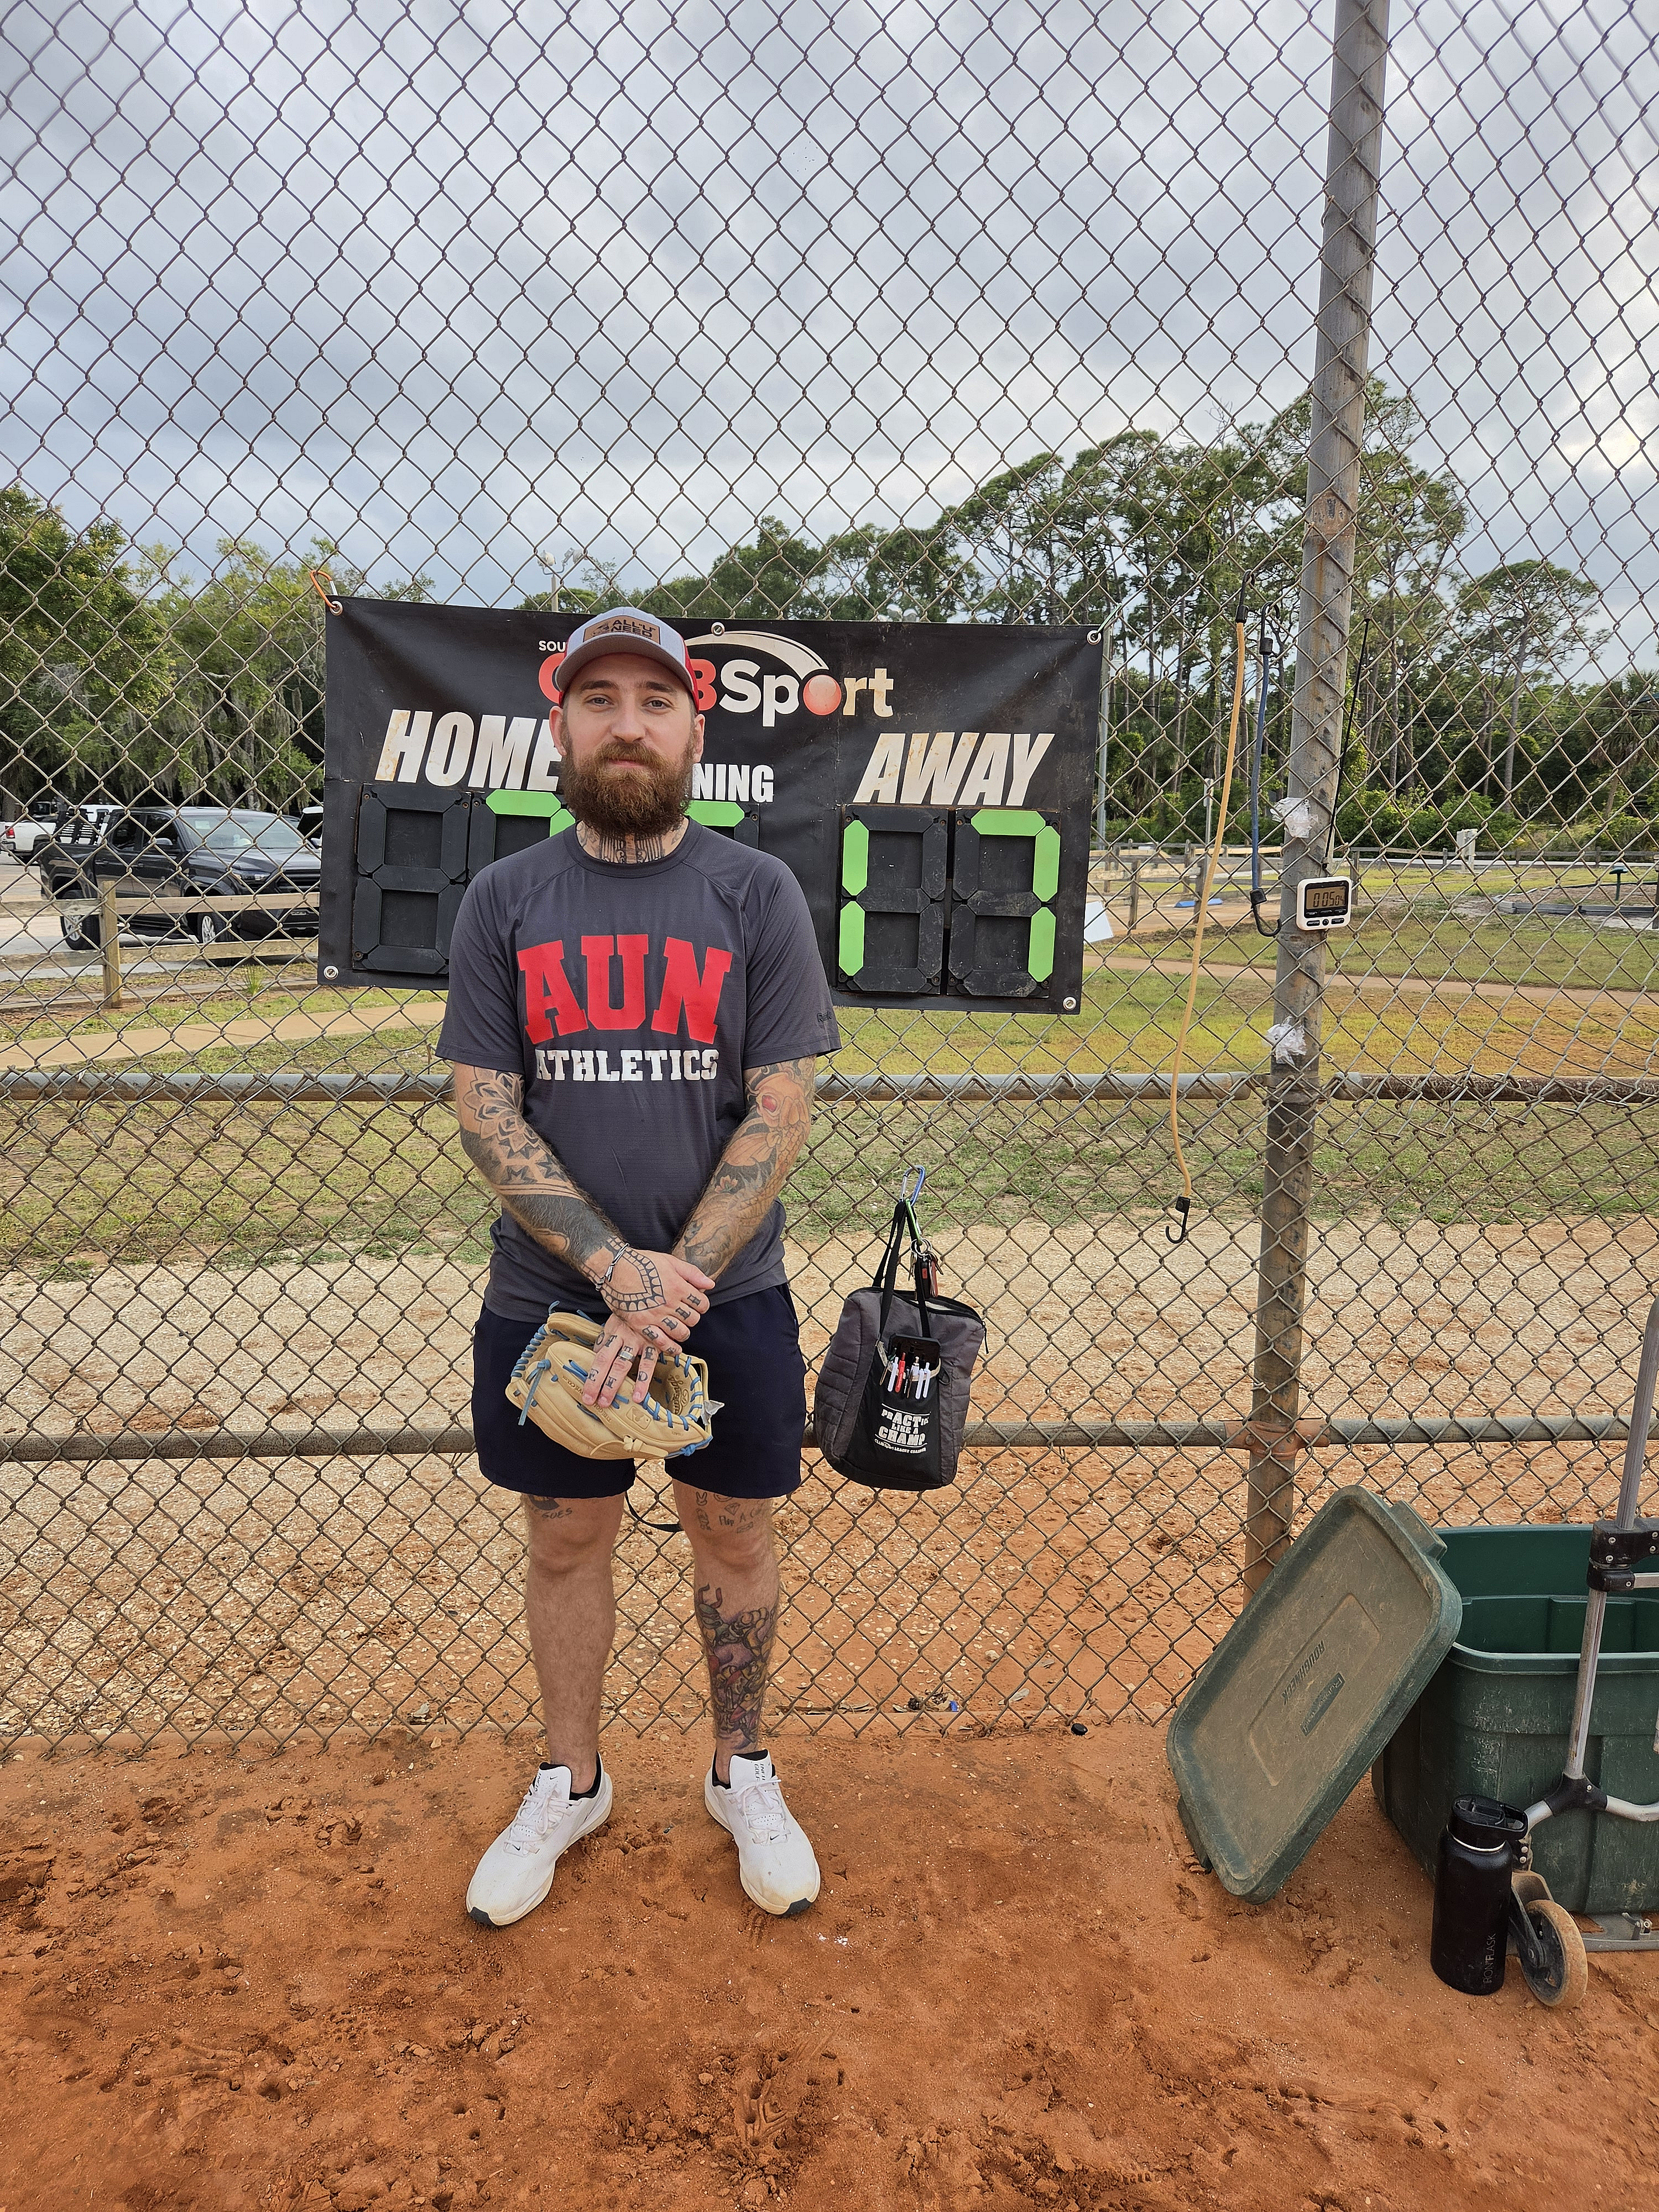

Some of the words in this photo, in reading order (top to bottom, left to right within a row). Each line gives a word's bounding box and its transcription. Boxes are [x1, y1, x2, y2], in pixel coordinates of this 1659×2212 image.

[611, 625, 653, 638] NEED
[374, 709, 563, 792] HOME
[852, 731, 1056, 807] AWAY
[692, 763, 774, 803] NING
[517, 933, 733, 1045] AUN
[535, 1048, 719, 1082] ATHLETICS
[878, 1426, 926, 1446] CHAMP
[891, 1422, 912, 1434] LIKE
